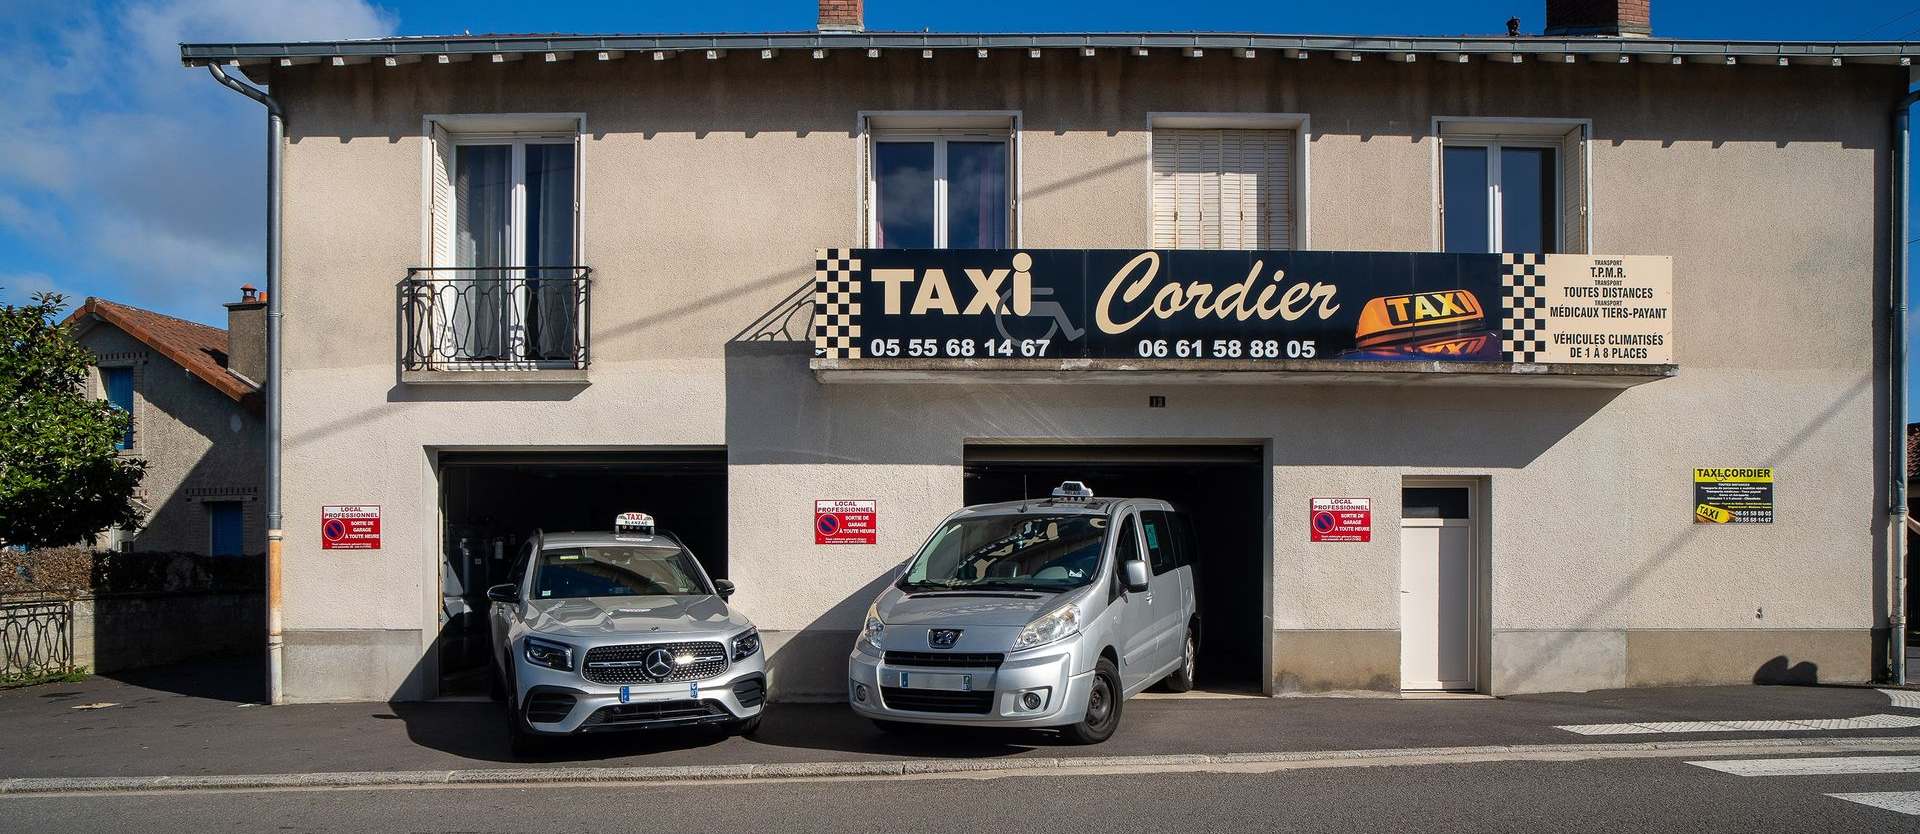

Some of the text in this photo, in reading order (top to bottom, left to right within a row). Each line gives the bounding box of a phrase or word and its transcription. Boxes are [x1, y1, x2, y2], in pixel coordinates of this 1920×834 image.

[1590, 267, 1626, 278] T.P.M.R.
[1095, 251, 1340, 334] Cordier
[1564, 286, 1653, 298] TOUTES DISTANCES
[1386, 292, 1476, 322] TAXI
[1550, 304, 1667, 318] MÉDICAUX TIERS-PAYANT
[1554, 331, 1664, 346] VÉHICULES CLIMATISÉS
[871, 339, 1050, 356] 05 55 68 14 67
[1138, 340, 1316, 358] 06 61 58 88 05
[1570, 345, 1647, 358] DE 1 À 8 PLACES
[1697, 469, 1770, 477] TAXI CORDIER
[1700, 506, 1719, 520] TAXI
